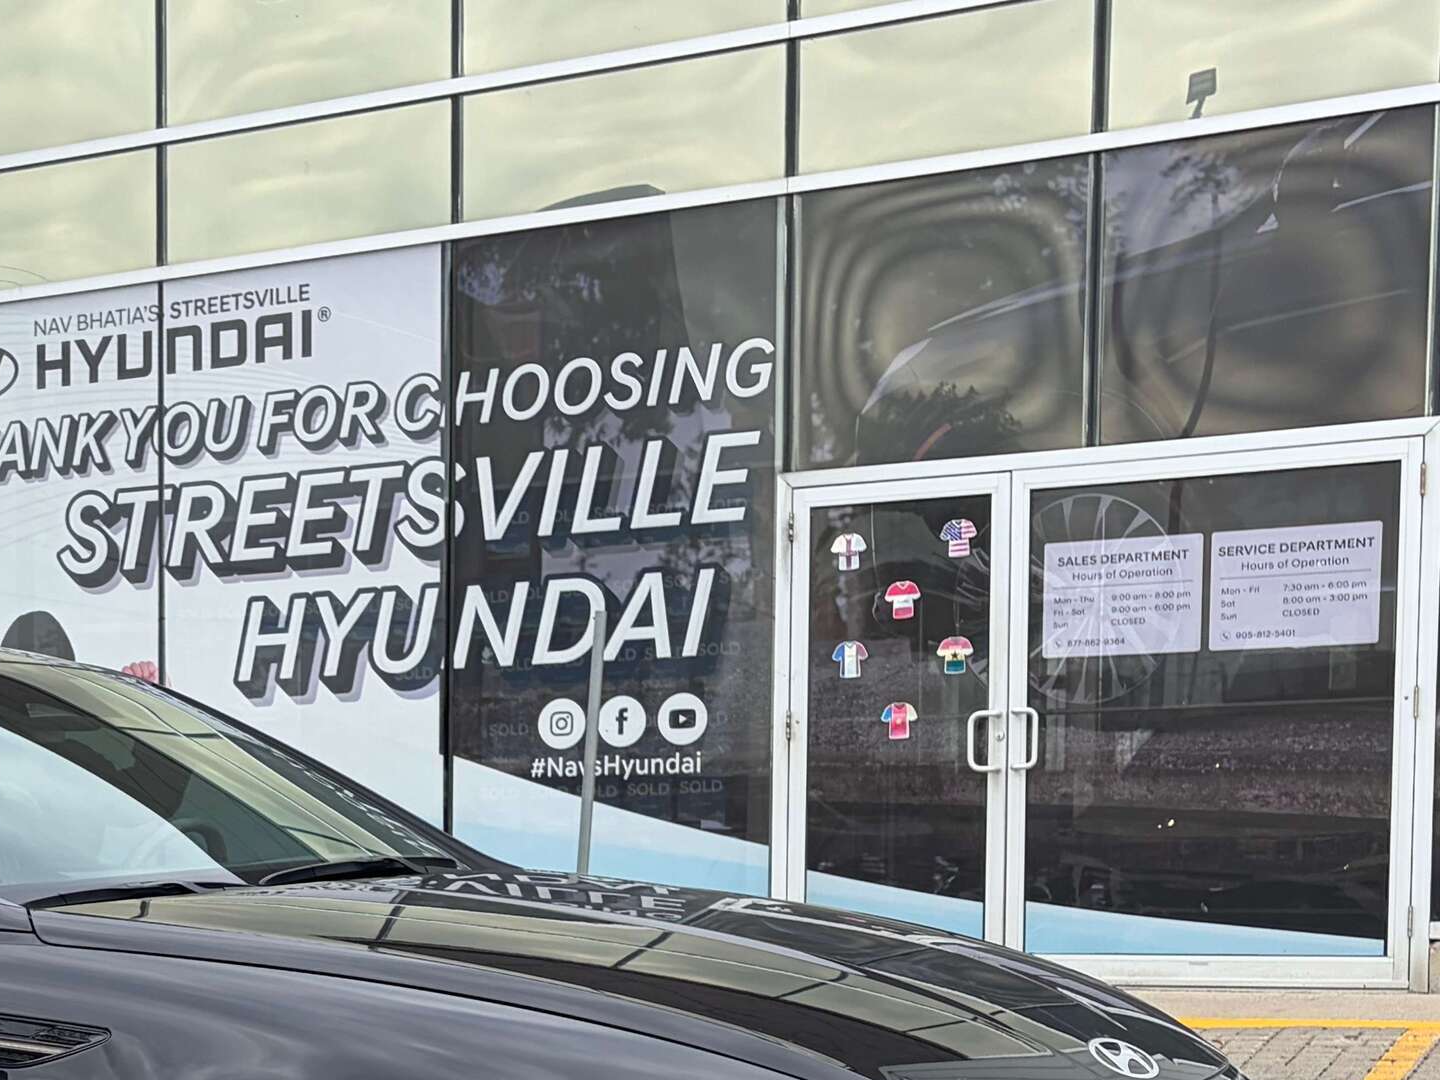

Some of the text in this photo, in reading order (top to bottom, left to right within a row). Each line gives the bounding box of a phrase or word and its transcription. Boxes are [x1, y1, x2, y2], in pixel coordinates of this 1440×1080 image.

[34, 284, 311, 337] NAV BHATIA'S STREETSVILLE
[119, 394, 252, 466] YOU
[258, 379, 385, 454] FOR
[394, 337, 775, 438] CHOOSING
[57, 430, 761, 584] STREETSVILLE
[1218, 536, 1375, 557] SERVICE DEPARTMENT
[1058, 549, 1190, 567] SALES DEPARTMENT
[1241, 556, 1349, 571] Hours of Operation
[1072, 567, 1173, 581] Hours of Operation
[1221, 587, 1240, 595] Mon
[1221, 600, 1235, 608] Sat
[1221, 613, 1237, 621] Sun
[1282, 608, 1320, 617] CLOSED
[1111, 617, 1146, 626] CLOSED
[235, 567, 718, 696] HYUNDAI
[679, 779, 723, 794] SOLD
